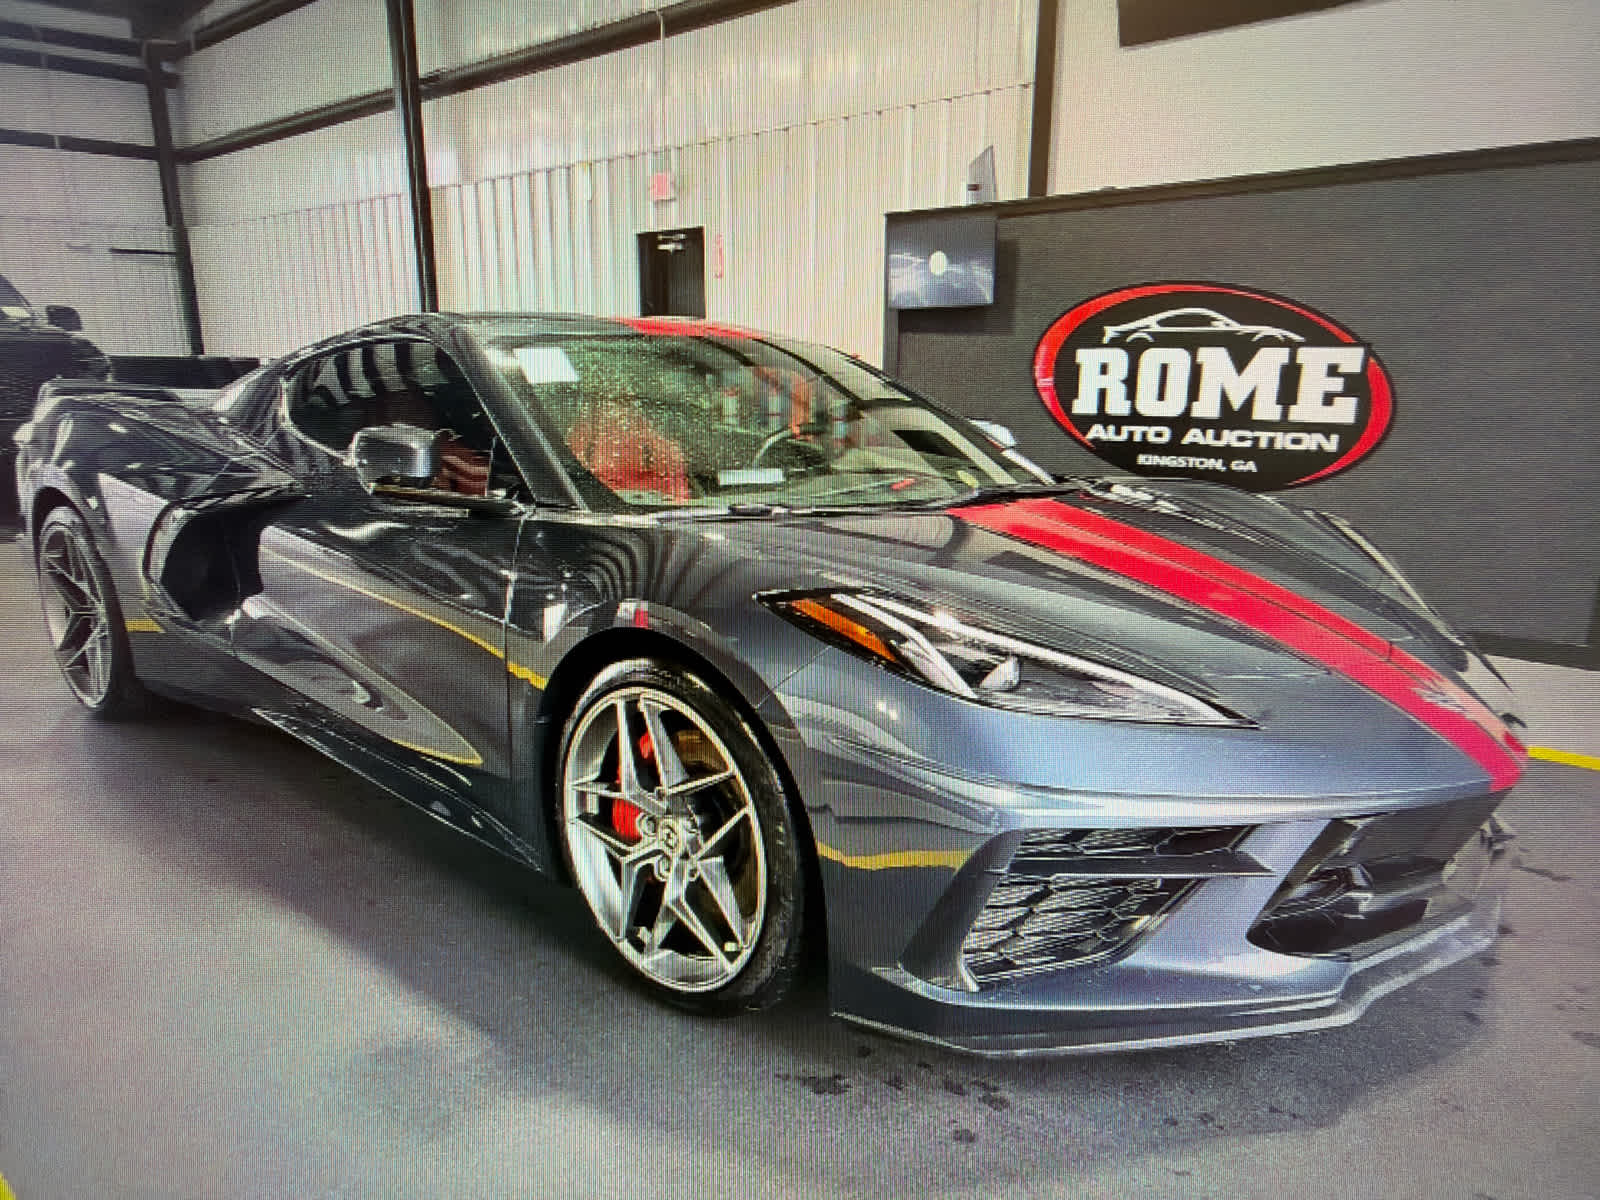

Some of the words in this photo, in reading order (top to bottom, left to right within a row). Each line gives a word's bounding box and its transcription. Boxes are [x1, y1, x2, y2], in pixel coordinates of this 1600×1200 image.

[1071, 346, 1364, 424] ROME
[1085, 424, 1172, 443] AUTO
[1181, 428, 1339, 452] AUCTION
[1137, 454, 1227, 472] KINGSTON,
[1231, 459, 1257, 473] GA
